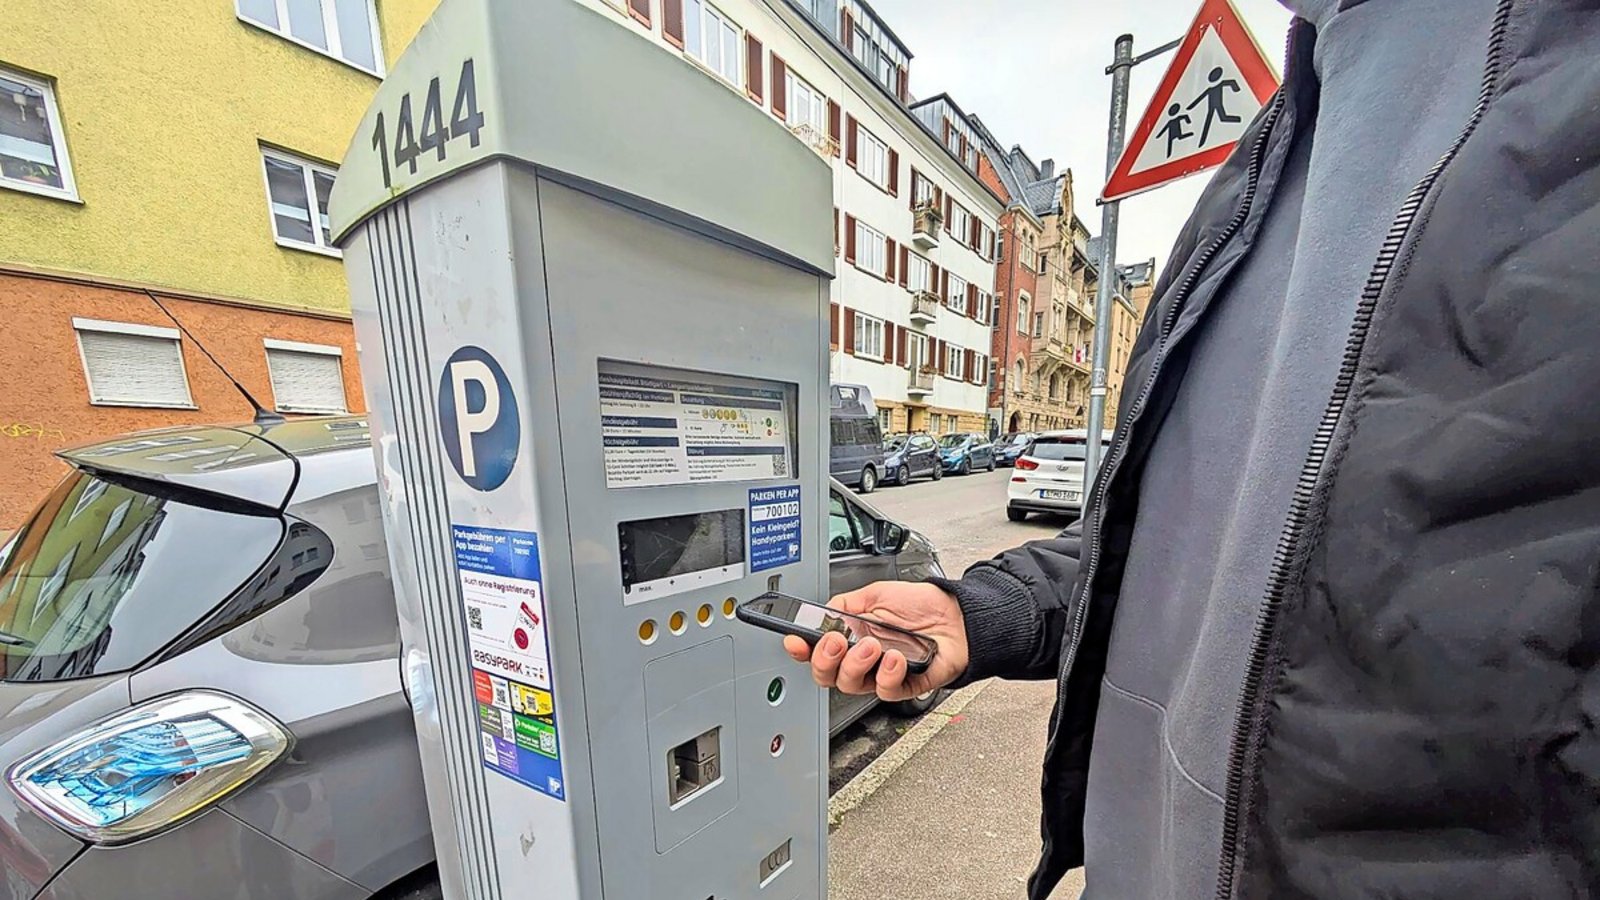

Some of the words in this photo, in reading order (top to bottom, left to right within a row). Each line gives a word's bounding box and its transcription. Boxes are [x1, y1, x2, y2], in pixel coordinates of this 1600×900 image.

[372, 58, 485, 189] 1444
[450, 359, 500, 477] P
[751, 490, 776, 502] PARKEN
[776, 489, 787, 500] PER
[788, 488, 800, 498] APP
[766, 503, 798, 518] 700102
[751, 524, 766, 535] Kein
[767, 519, 800, 532] Kleingeld?
[454, 529, 494, 544] Parkgebühren
[751, 531, 797, 546] Handyparken!
[455, 540, 467, 551] App
[468, 542, 494, 553] bezahlen
[493, 583, 536, 598] Registrierung
